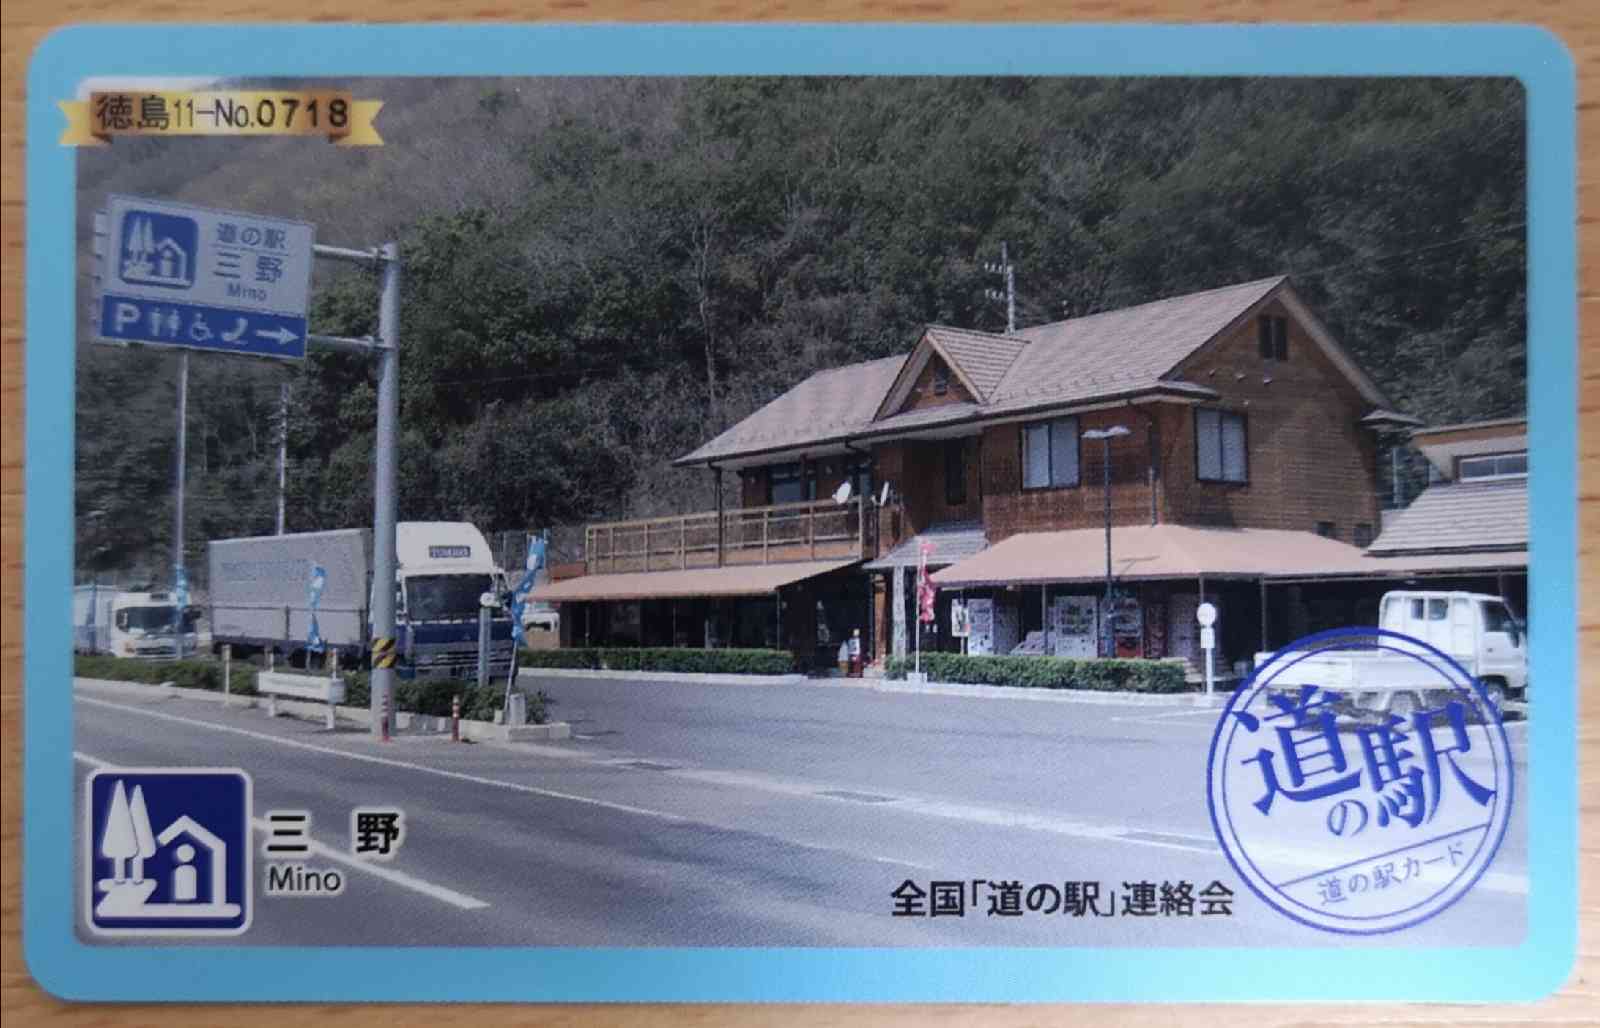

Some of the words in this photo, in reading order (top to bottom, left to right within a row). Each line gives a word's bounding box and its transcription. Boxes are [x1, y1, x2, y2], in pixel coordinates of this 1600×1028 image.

[215, 222, 286, 250] 道の駅
[212, 251, 284, 283] 三野
[227, 283, 267, 301] Mino
[114, 304, 142, 333] P
[268, 865, 342, 893] Mino
[1317, 840, 1465, 906] 道の駅カード
[890, 879, 1236, 918] 全国「道の駅」連絡会
